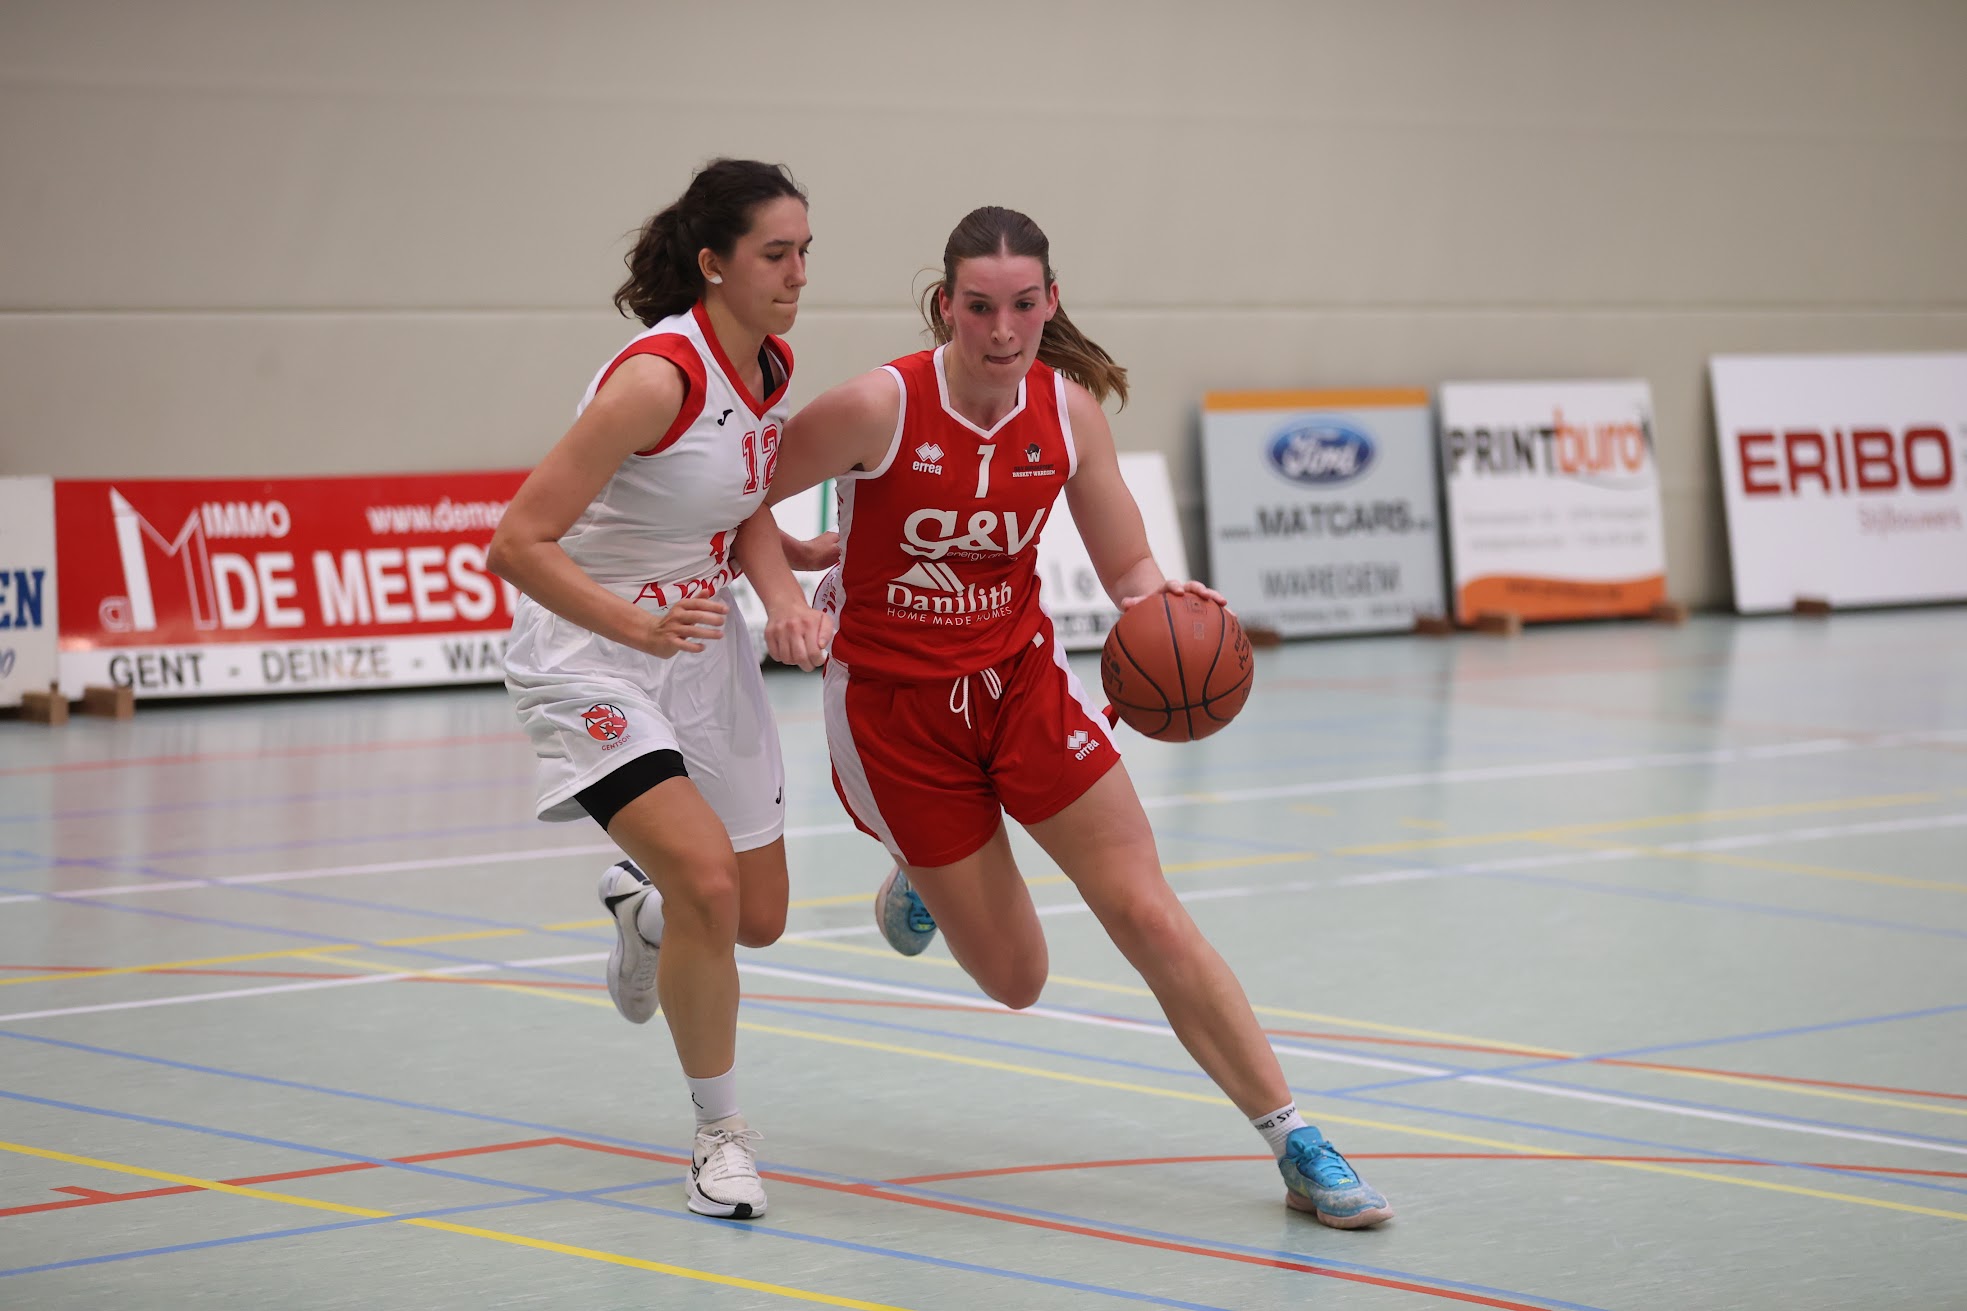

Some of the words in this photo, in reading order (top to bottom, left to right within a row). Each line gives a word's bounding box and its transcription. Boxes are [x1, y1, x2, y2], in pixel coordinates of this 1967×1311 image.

[741, 424, 778, 495] 12
[912, 460, 943, 476] errea
[1284, 431, 1358, 479] Ford
[1736, 427, 1954, 495] ERIBO
[201, 500, 291, 539] IMMO
[212, 551, 306, 630] DE
[887, 581, 1012, 614] Danilith
[887, 607, 928, 622] HOME
[932, 615, 972, 626] MADE
[109, 652, 204, 688] GENT
[261, 643, 391, 684] DEINZE
[1075, 739, 1100, 761] errea
